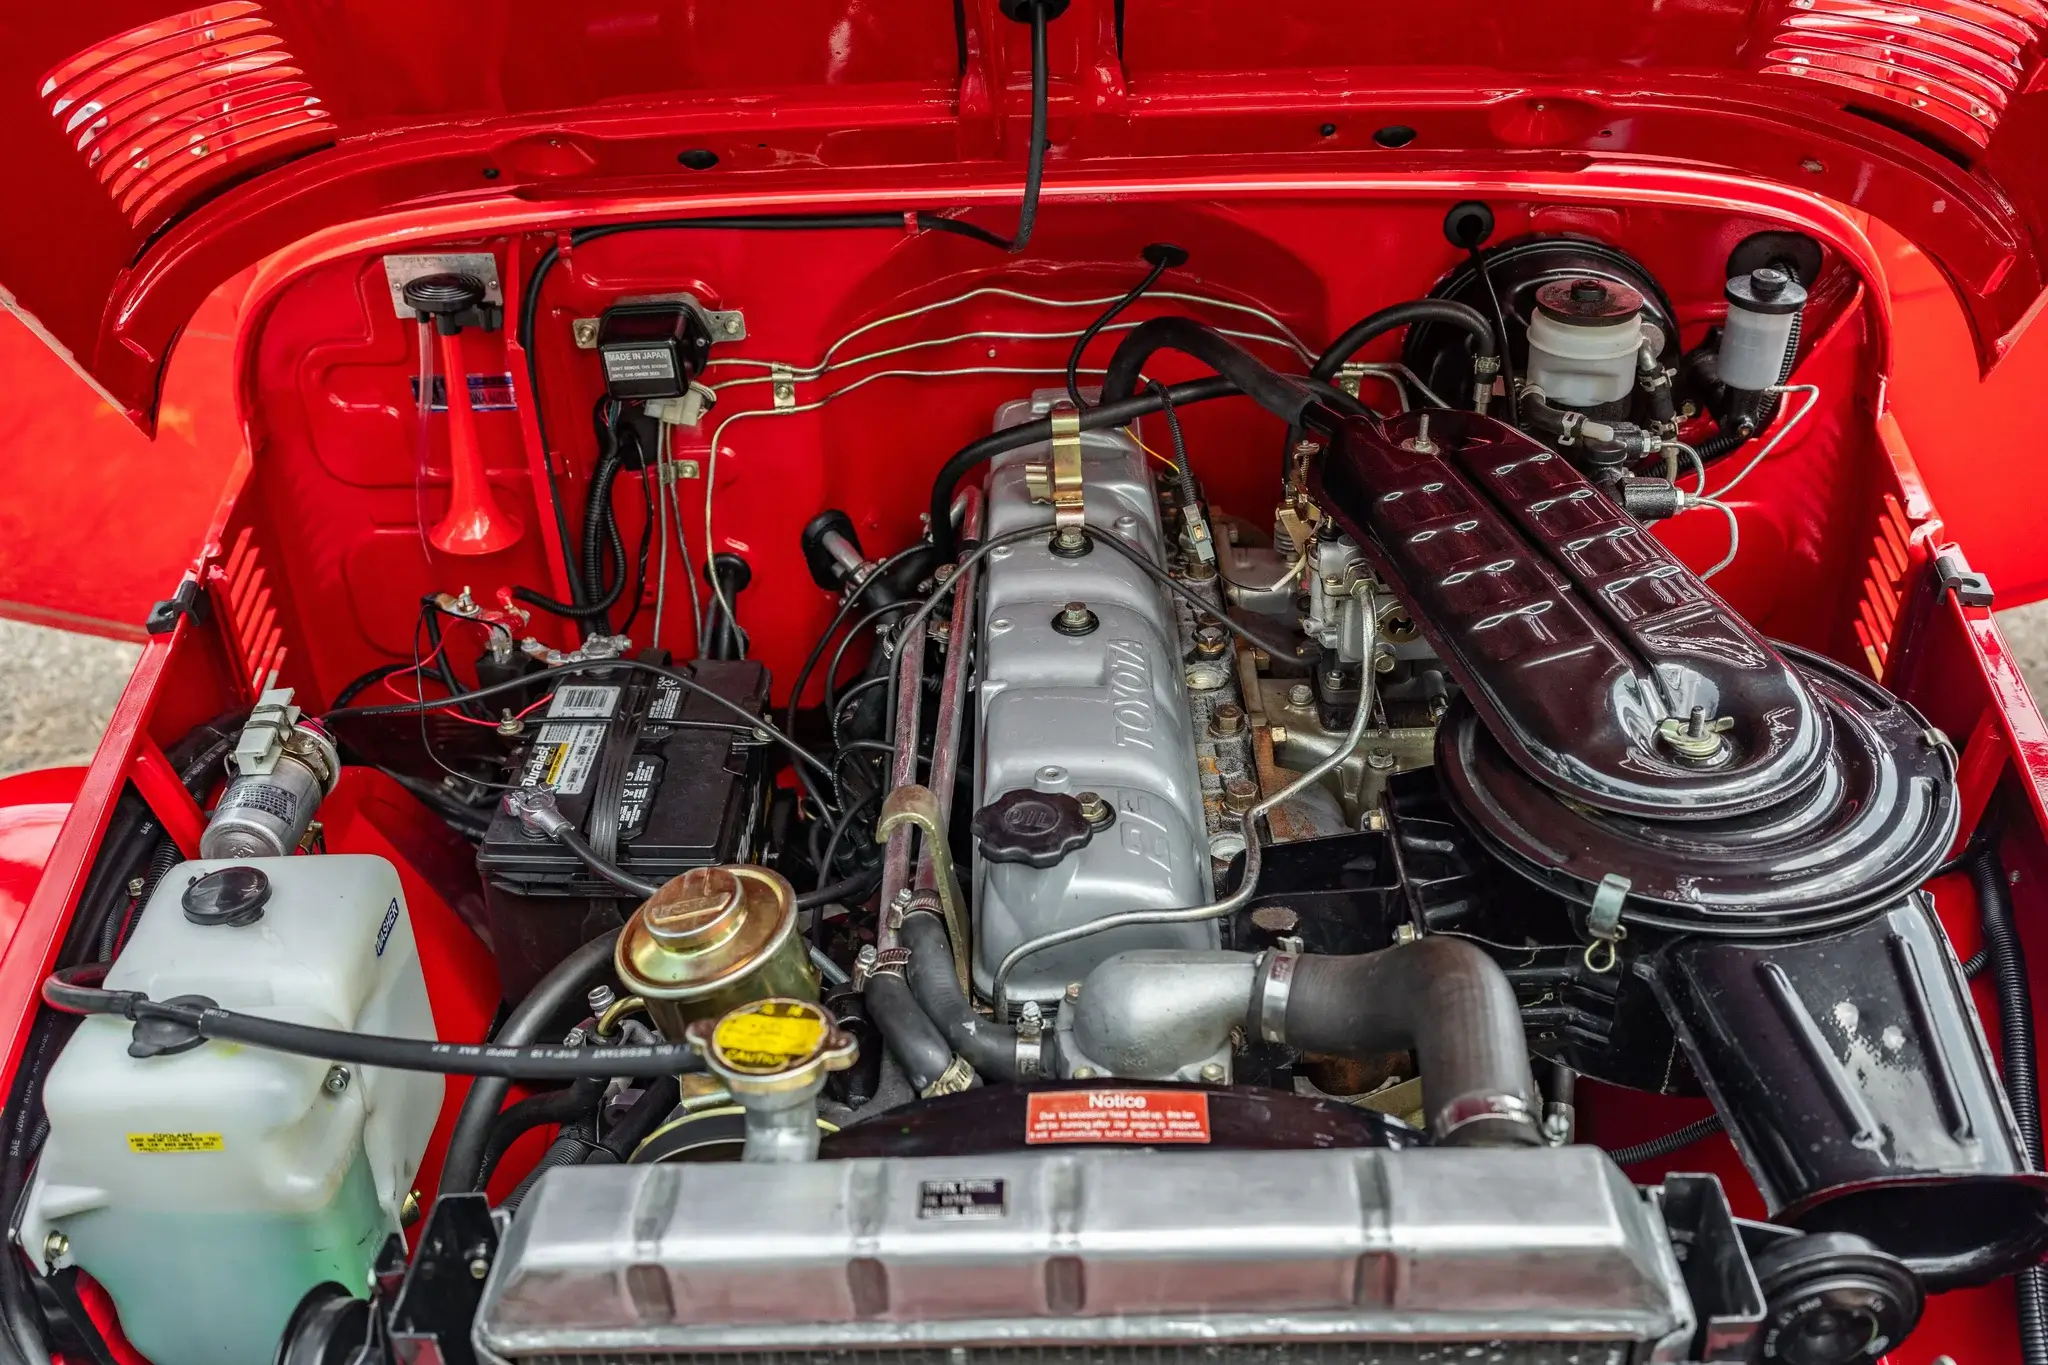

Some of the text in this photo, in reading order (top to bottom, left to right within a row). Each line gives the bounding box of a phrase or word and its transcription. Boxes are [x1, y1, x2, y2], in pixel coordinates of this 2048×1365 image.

[608, 351, 667, 361] MADE IN JAPAN
[1107, 639, 1154, 750] TOYOTA
[521, 745, 551, 787] Duralast
[1004, 808, 1052, 829] OIL
[140, 821, 153, 835] SAE
[375, 902, 398, 954] WASHER
[591, 1047, 653, 1059] RESISTANT
[1088, 1093, 1147, 1108] Notice
[9, 1139, 21, 1157] SAE
